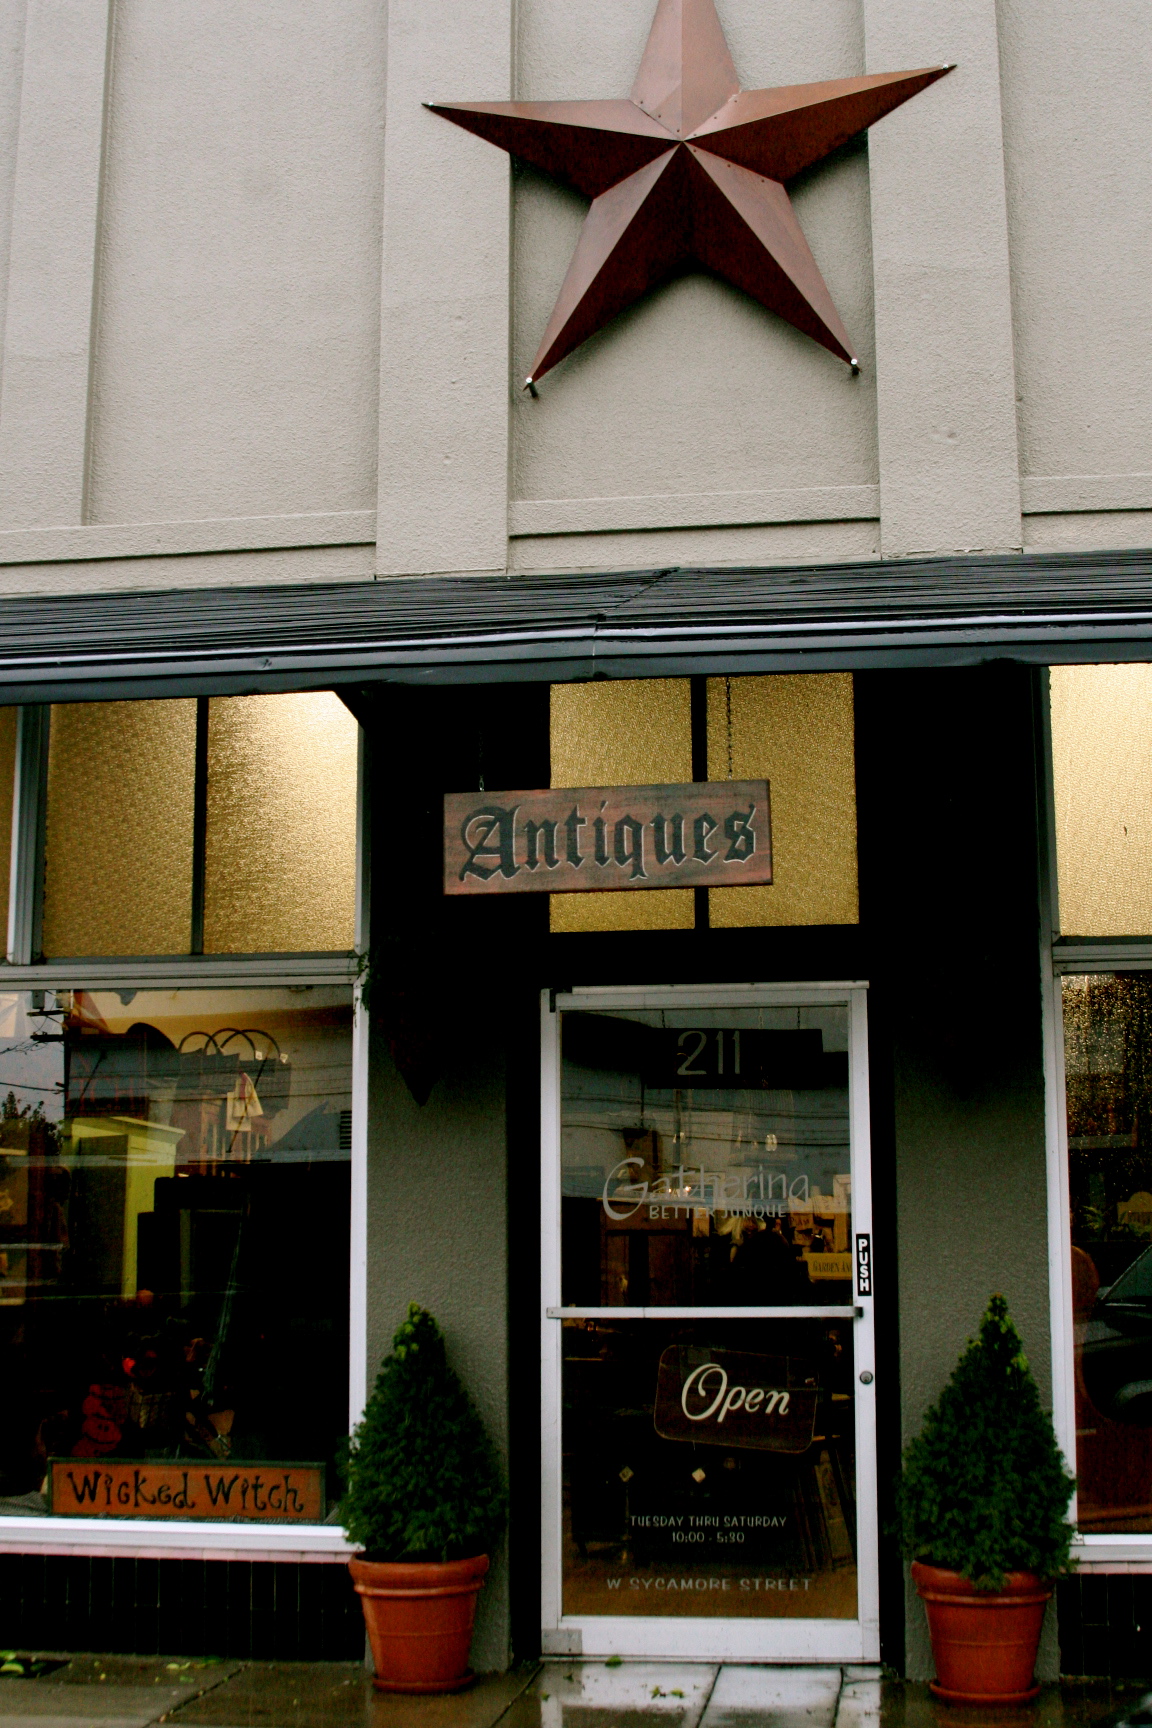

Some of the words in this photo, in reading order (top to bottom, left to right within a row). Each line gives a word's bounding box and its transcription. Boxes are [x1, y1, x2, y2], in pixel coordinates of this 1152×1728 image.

[459, 800, 757, 883] Antiques
[676, 1030, 741, 1076] 211
[602, 1156, 809, 1221] Gathering
[649, 1205, 716, 1220] BETTER
[721, 1205, 787, 1220] JUNQUE
[858, 1238, 871, 1292] PUSH
[681, 1363, 791, 1423] Open
[66, 1469, 197, 1510] Wicked
[203, 1473, 305, 1513] Witch
[630, 1515, 684, 1528] TUESDAY
[688, 1515, 720, 1528] THRU
[723, 1515, 787, 1528] SATURDAY
[672, 1531, 705, 1544] 10:00
[606, 1578, 622, 1591] W
[629, 1577, 732, 1591] SYCAMORE
[739, 1577, 813, 1591] STREET
